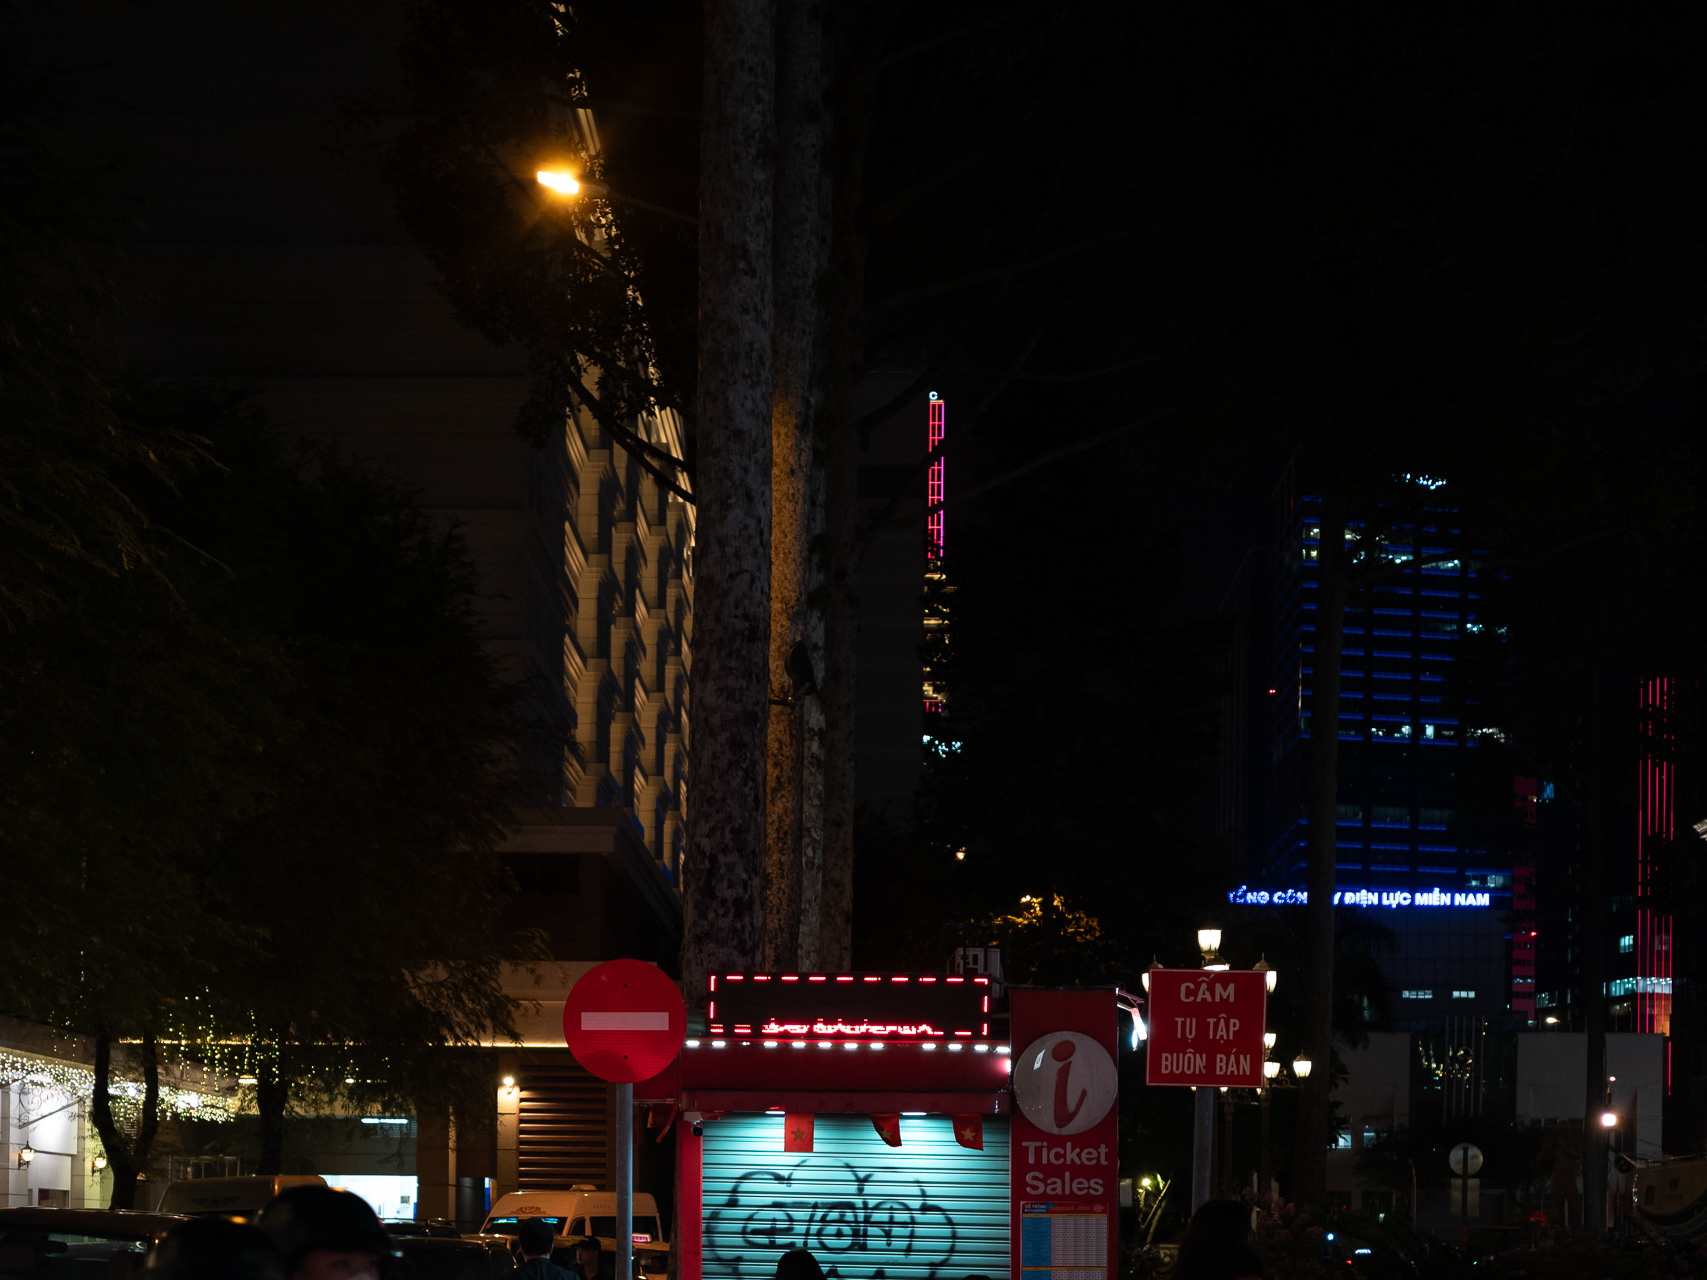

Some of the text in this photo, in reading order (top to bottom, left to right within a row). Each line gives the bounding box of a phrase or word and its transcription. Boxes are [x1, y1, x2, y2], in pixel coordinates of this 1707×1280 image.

[1273, 888, 1308, 905] CÔN
[1344, 889, 1379, 908] ĐIỆN
[1382, 890, 1412, 909] LỰC
[1454, 892, 1490, 906] NAM
[1180, 974, 1235, 1002] CẤM
[1175, 1013, 1240, 1044] TỤ TẬP
[1161, 1048, 1250, 1075] BUÔN BÁN
[1021, 1141, 1109, 1166] Ticket
[1025, 1171, 1105, 1196] Sales
